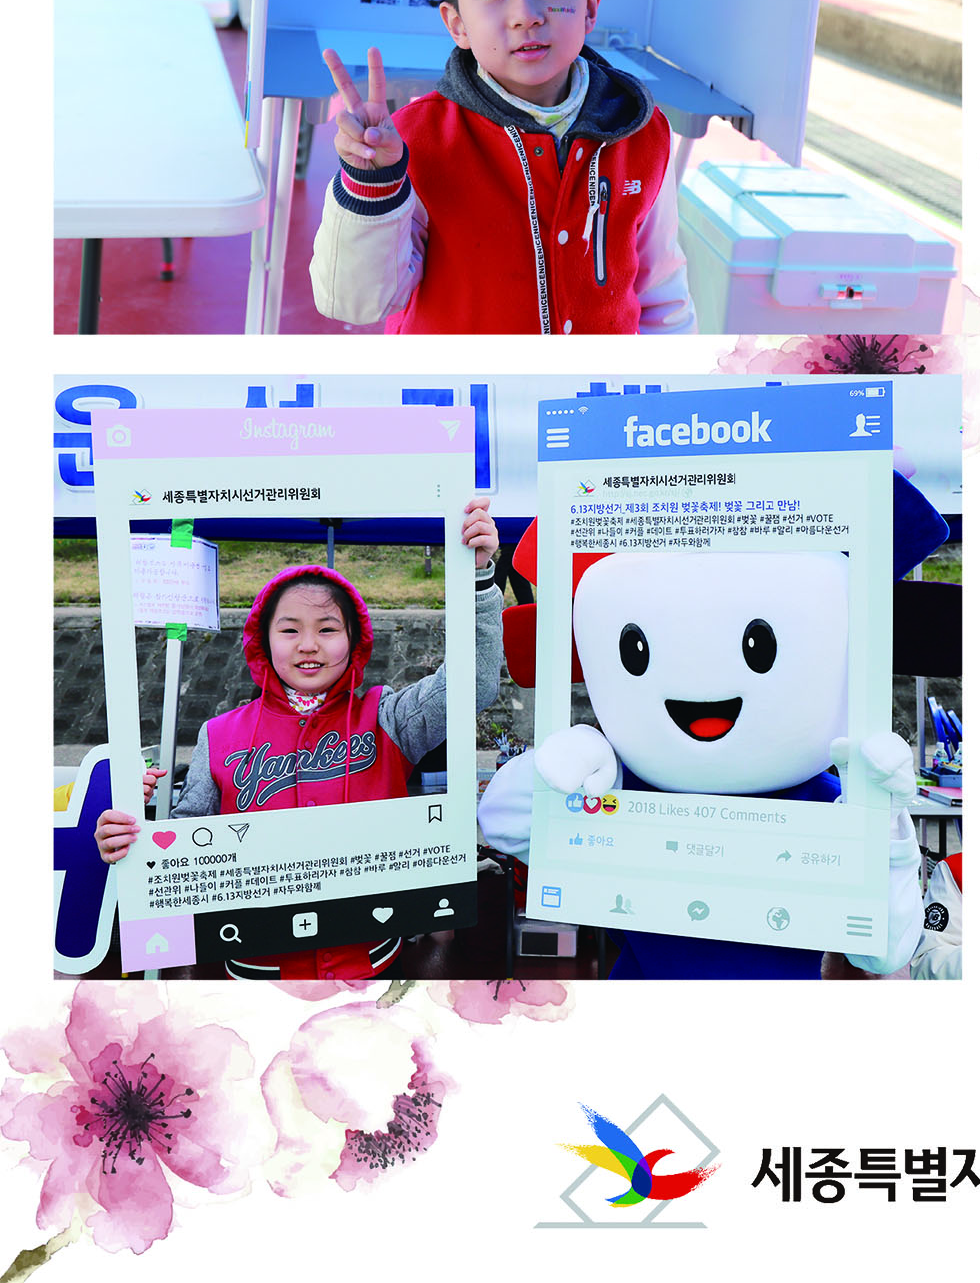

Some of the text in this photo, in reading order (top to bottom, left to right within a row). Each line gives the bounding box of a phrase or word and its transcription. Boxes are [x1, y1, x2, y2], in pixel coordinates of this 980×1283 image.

[849, 388, 865, 398] 69%
[239, 416, 336, 451] Instagram
[623, 411, 773, 449] facebook
[602, 472, 737, 489] 세종특별자치시선거관리위원회
[161, 487, 322, 504] 세종특별자치시선거관리위원회
[651, 501, 679, 513] 조치원
[681, 500, 722, 514] 벚꽃축제!
[724, 500, 744, 513] 벚꽃
[745, 499, 775, 512] 그리고
[776, 499, 801, 512] 만남!
[570, 516, 624, 527] #조치원벚꽃축제
[625, 514, 735, 527] #세종특별자치시선거관리위원회
[736, 513, 758, 525] #벚꽃
[782, 513, 804, 524] #선거
[806, 513, 834, 523] #VOTE
[597, 526, 624, 538] #나들이
[624, 526, 645, 538] #커플
[646, 526, 673, 536] #데이트
[674, 525, 726, 536] #투표하러가자
[749, 524, 771, 537] #바루
[795, 524, 850, 536] #아름다운선거
[570, 536, 712, 549] #행복한세종시 #6.13지방선거 #자두와함께
[222, 730, 379, 813] Yankees
[627, 800, 788, 824] 2018 Likes 407 Comments
[587, 834, 615, 848] 좋아요
[349, 852, 373, 866] #벚꽃
[398, 847, 421, 859] #선거
[422, 844, 452, 855] #VOTE
[686, 842, 725, 858] 댓글달기
[160, 856, 190, 870] 좋아요
[800, 851, 842, 867] 공유하기
[148, 885, 182, 897] #선관위
[184, 880, 218, 893] #나들이
[244, 875, 278, 887] #데이트
[279, 869, 338, 883] #투표하러가자
[412, 853, 467, 868] #아름다운선거
[211, 886, 271, 902] #6.13지방선거
